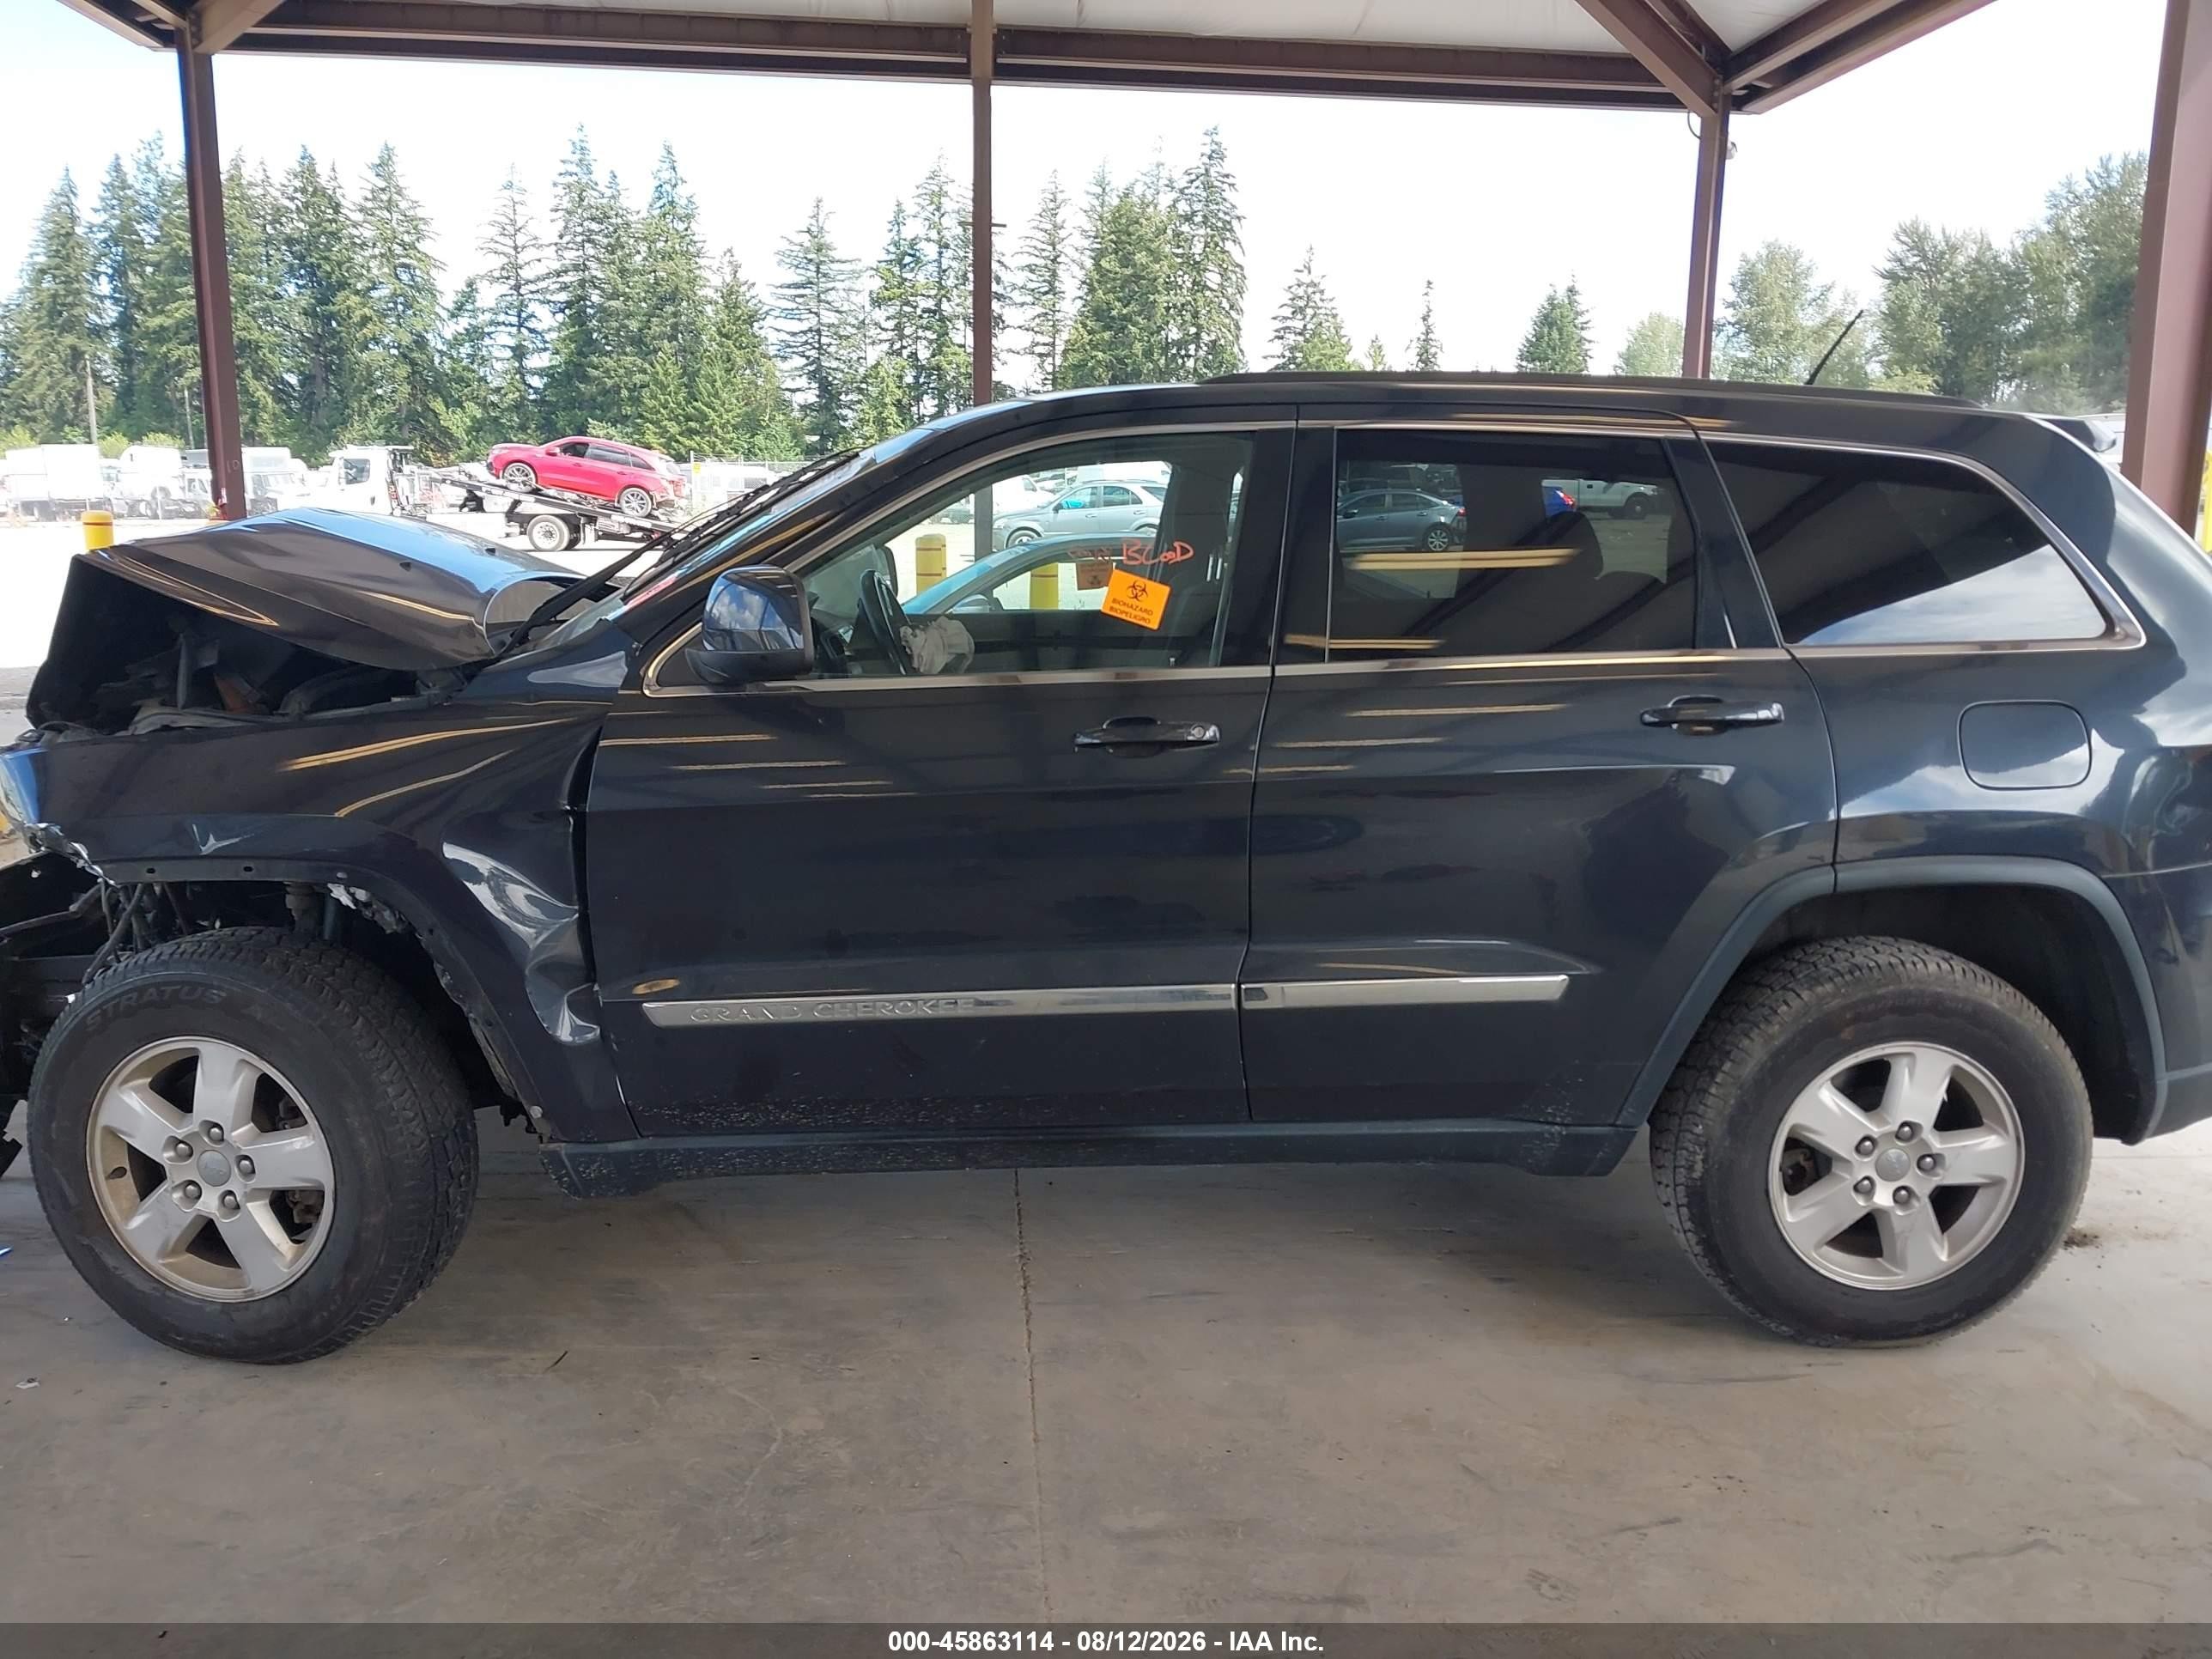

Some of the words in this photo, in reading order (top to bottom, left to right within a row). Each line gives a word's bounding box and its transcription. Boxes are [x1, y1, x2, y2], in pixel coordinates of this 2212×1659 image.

[1109, 605, 1152, 624] BIOPELIGRO
[1111, 598, 1154, 617] BIOHAZARD
[85, 985, 227, 1029] STRATUS
[690, 1005, 802, 1024] GRAND
[812, 998, 977, 1019] CHEROKEE
